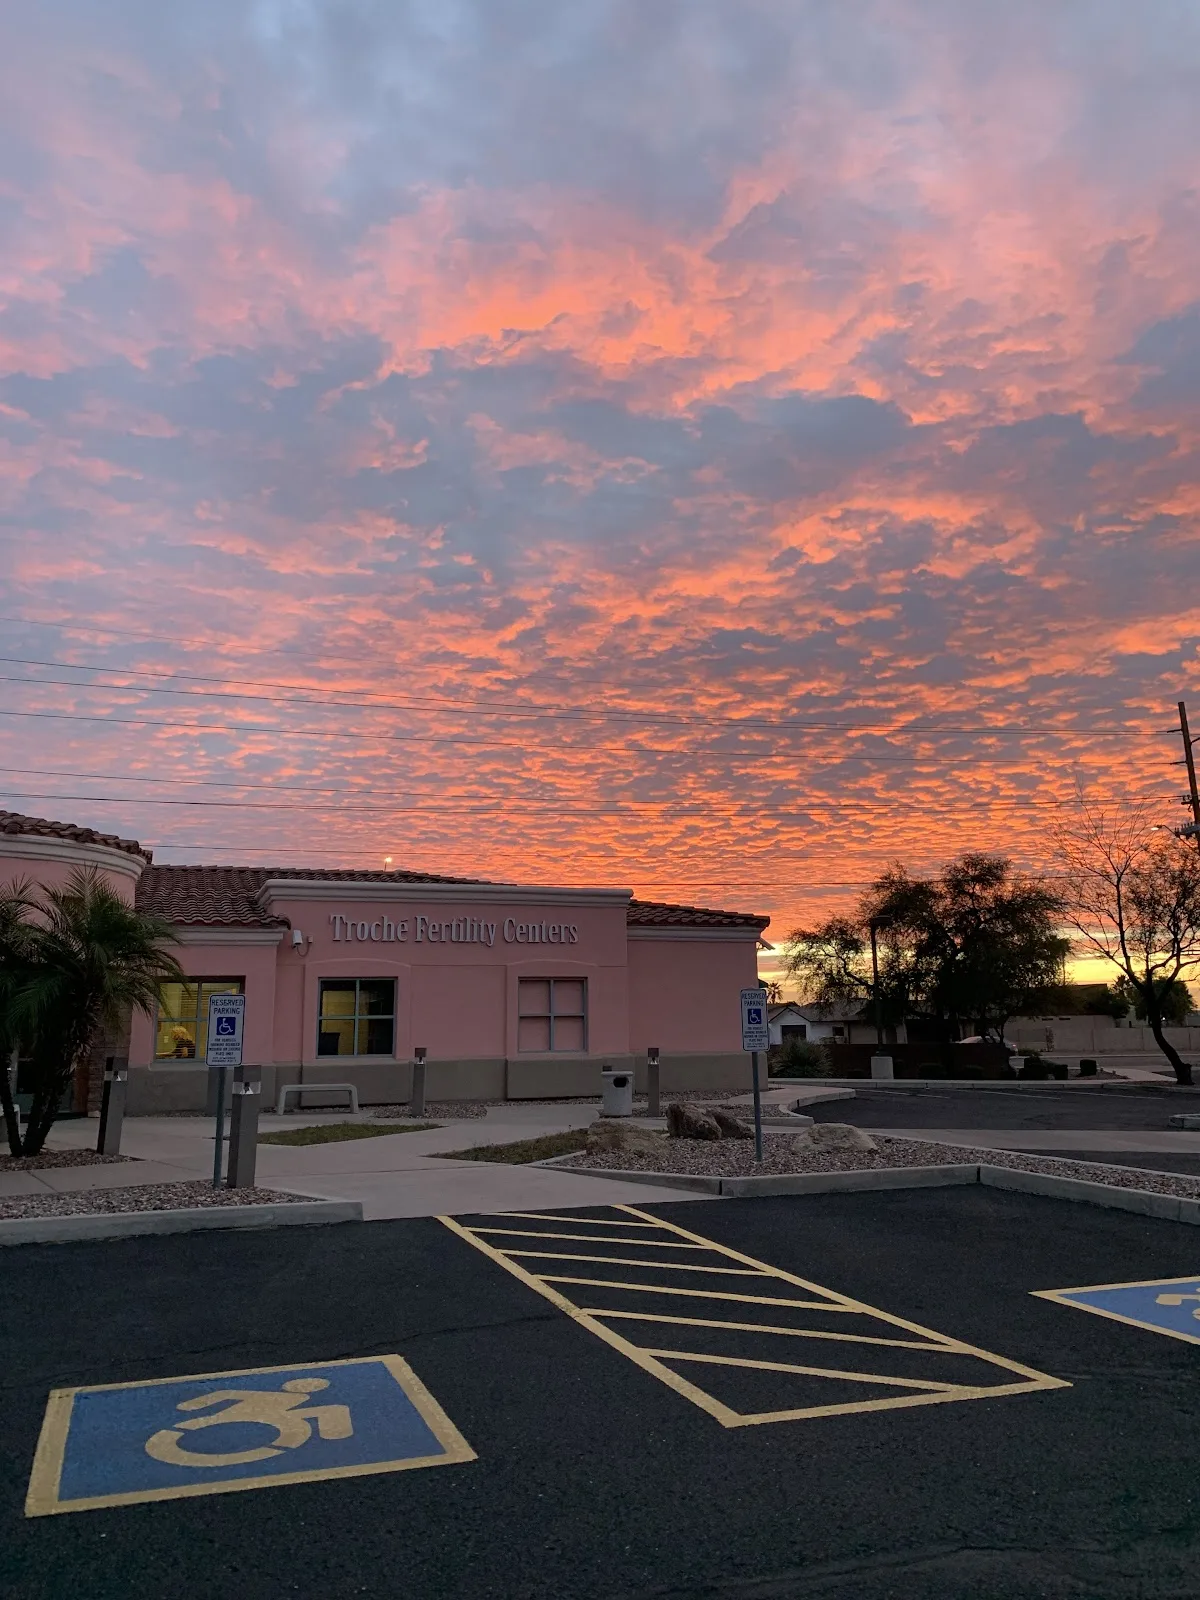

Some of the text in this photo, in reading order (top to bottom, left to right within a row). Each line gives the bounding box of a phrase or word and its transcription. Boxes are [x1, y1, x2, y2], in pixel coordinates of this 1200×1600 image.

[329, 913, 579, 947] Troché Fertility Centers
[742, 992, 765, 1000] RESERVED
[213, 1007, 240, 1015] PARKING
